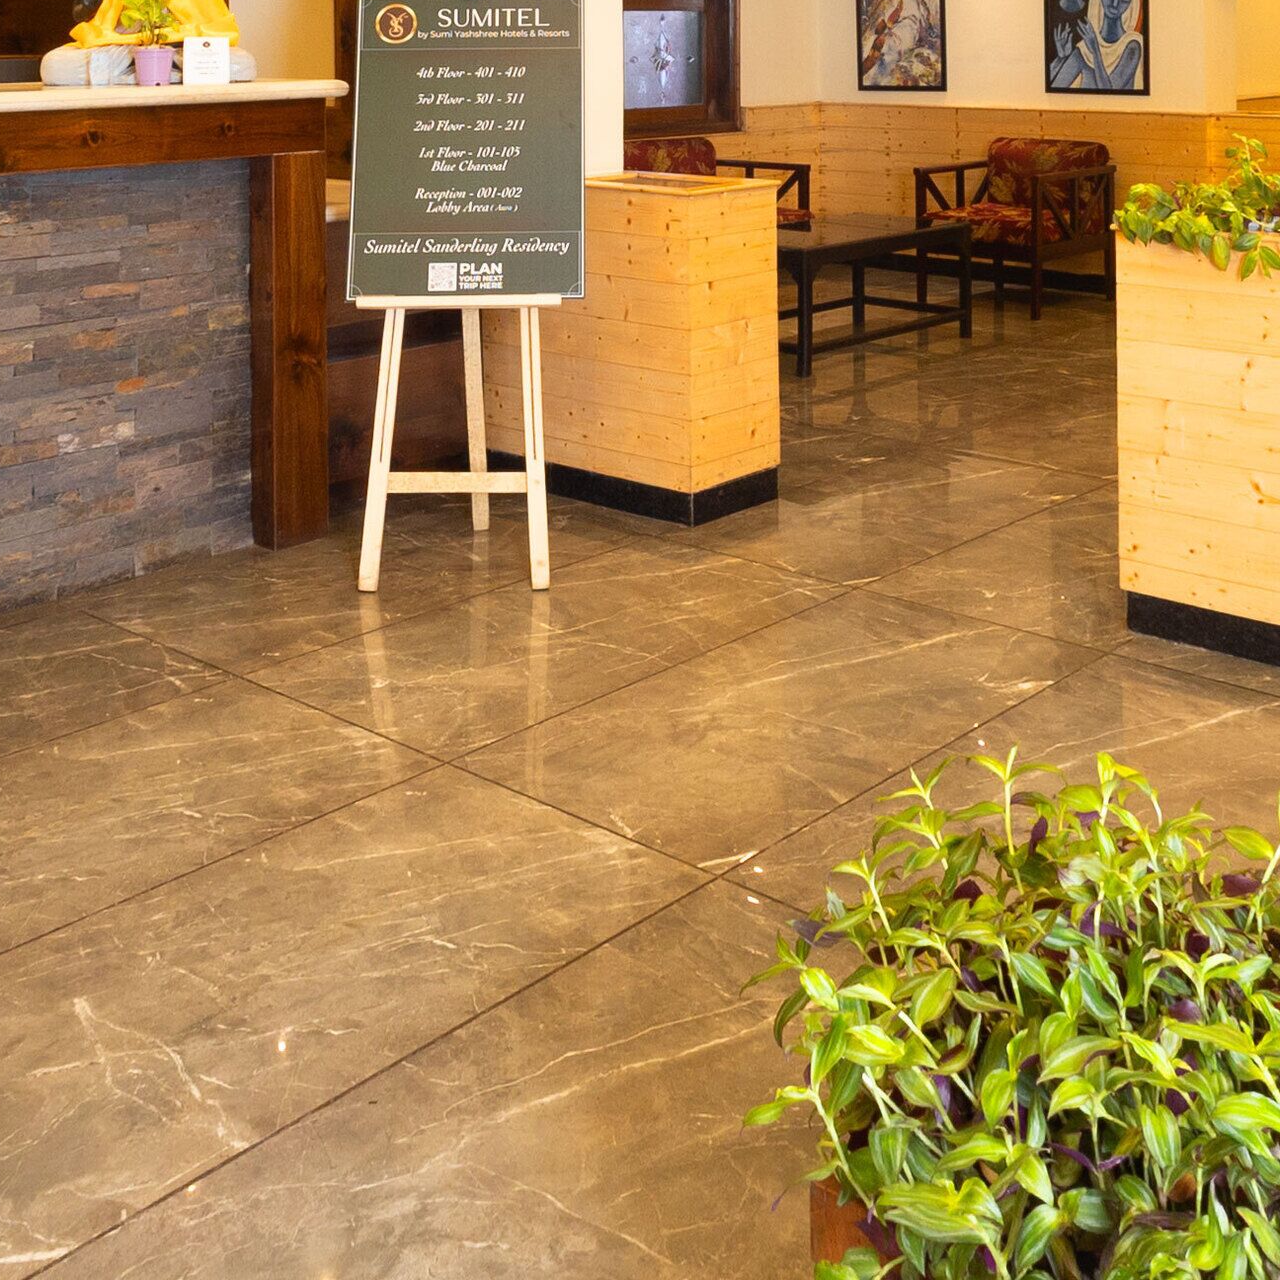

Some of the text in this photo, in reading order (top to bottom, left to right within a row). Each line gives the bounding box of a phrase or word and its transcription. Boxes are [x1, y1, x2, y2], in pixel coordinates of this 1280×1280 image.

[437, 7, 550, 28] SUMITEL
[417, 29, 570, 40] by Sumi Yashshree Hotels & Resorts
[416, 66, 434, 79] 4th
[436, 66, 465, 79] Floor
[474, 66, 495, 78] 401
[504, 66, 526, 78] 410
[416, 93, 434, 105] 3rd
[435, 93, 465, 105] Floor
[474, 93, 495, 105] 301
[504, 92, 525, 104] 311
[413, 120, 435, 132] 2nd
[436, 119, 465, 132] Floor
[474, 119, 495, 131] 201
[504, 119, 526, 131] 211
[418, 147, 435, 159] 1st
[436, 146, 466, 158] Floor
[431, 159, 509, 172] Blue Charcoal
[414, 187, 466, 201] Reception
[476, 186, 523, 199] 001-002
[425, 201, 461, 215] Lobby
[462, 201, 490, 213] Area
[363, 236, 571, 256] Sumitel Sanderling Residency
[459, 262, 503, 275] PLAN
[458, 274, 504, 282] YOUR NEXT
[458, 281, 504, 290] TRIP HERE
